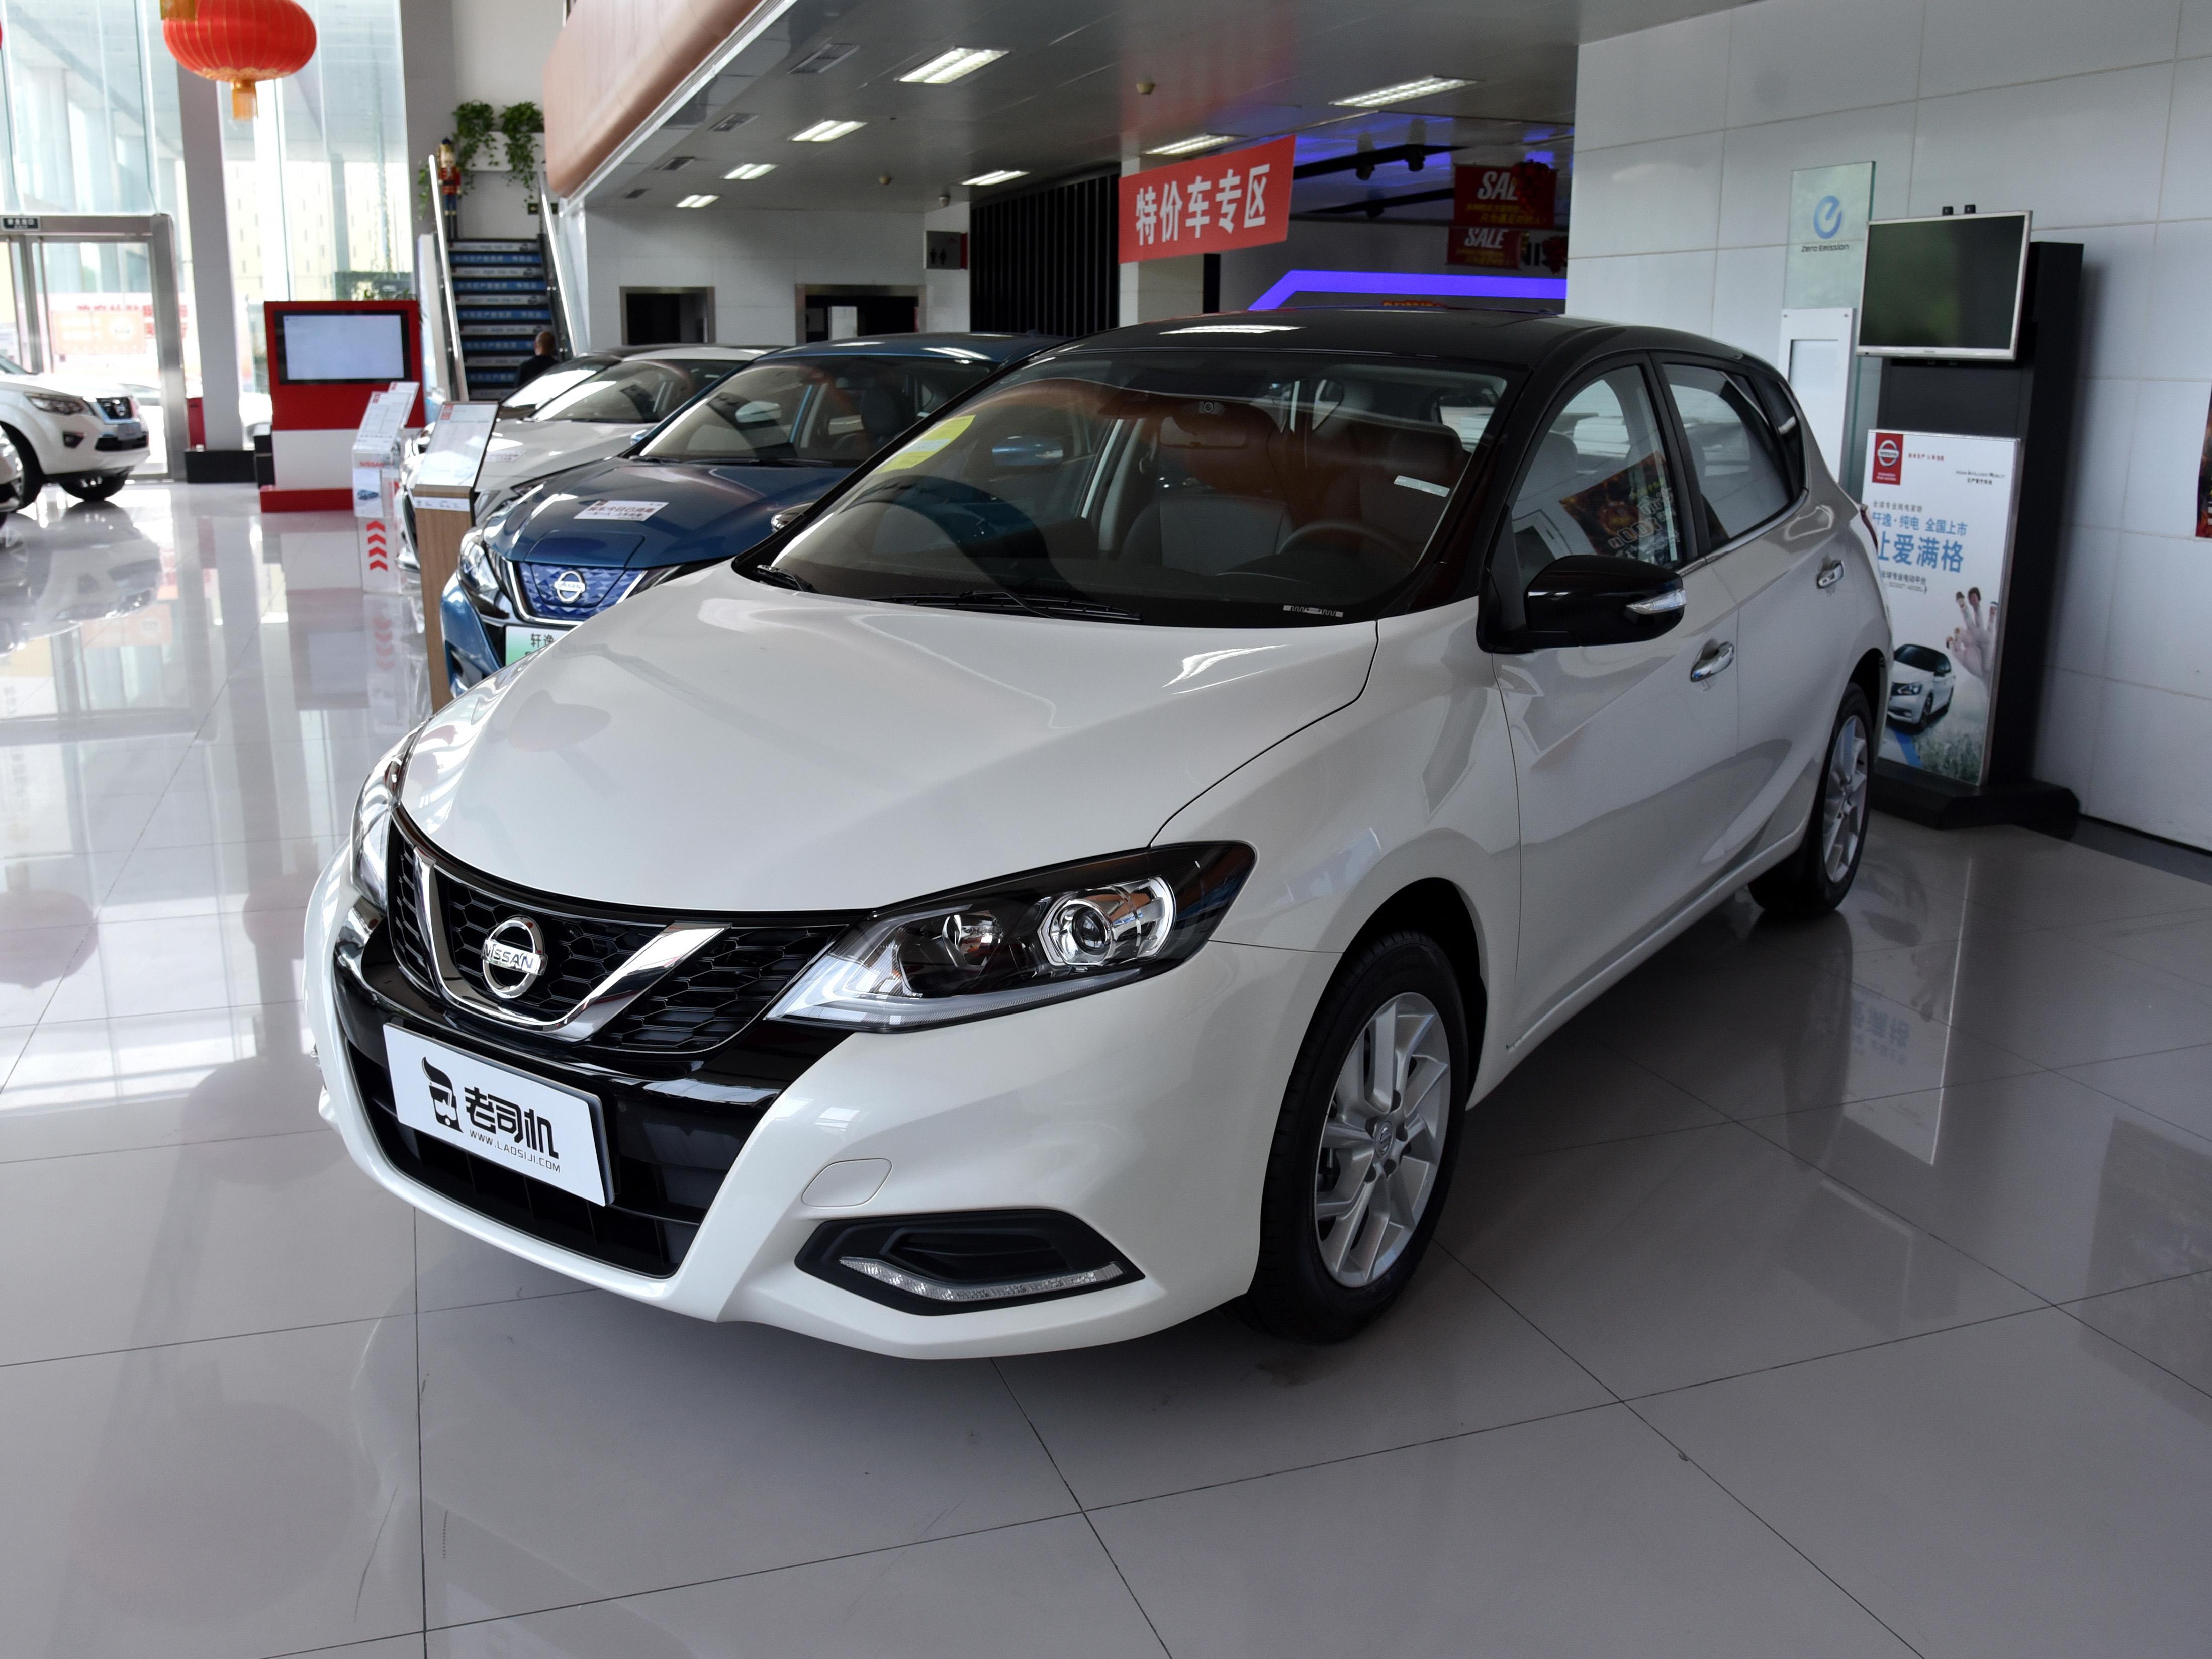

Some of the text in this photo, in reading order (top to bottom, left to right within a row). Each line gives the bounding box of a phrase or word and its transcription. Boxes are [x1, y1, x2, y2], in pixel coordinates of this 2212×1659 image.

[1476, 171, 1519, 200] SAL
[1136, 164, 1270, 246] 特价车专区
[1464, 228, 1510, 249] SALE
[1925, 517, 1968, 536] 全国上市
[484, 943, 534, 969] NISSAN
[464, 1086, 559, 1159] 老司机
[470, 1129, 560, 1173] WWW.LAOSIJI.COM
